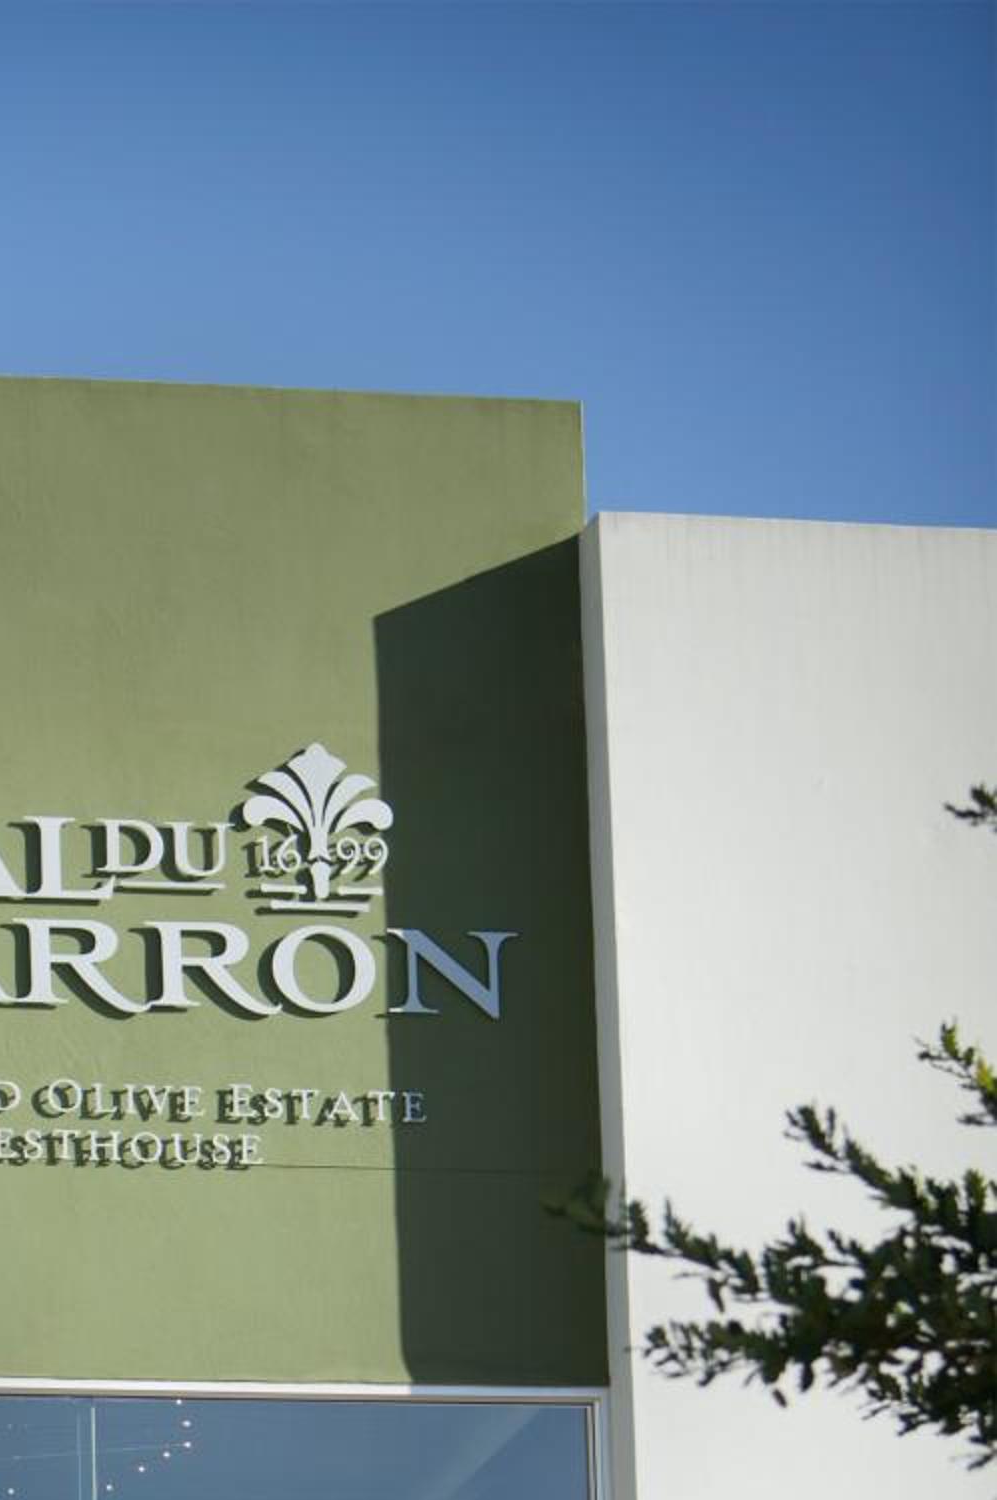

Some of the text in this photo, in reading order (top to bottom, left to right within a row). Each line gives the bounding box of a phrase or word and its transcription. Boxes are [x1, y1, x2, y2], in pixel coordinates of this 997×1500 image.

[95, 818, 235, 878] DU
[47, 1078, 204, 1117] OLIVE
[228, 1083, 427, 1123] ESTATE
